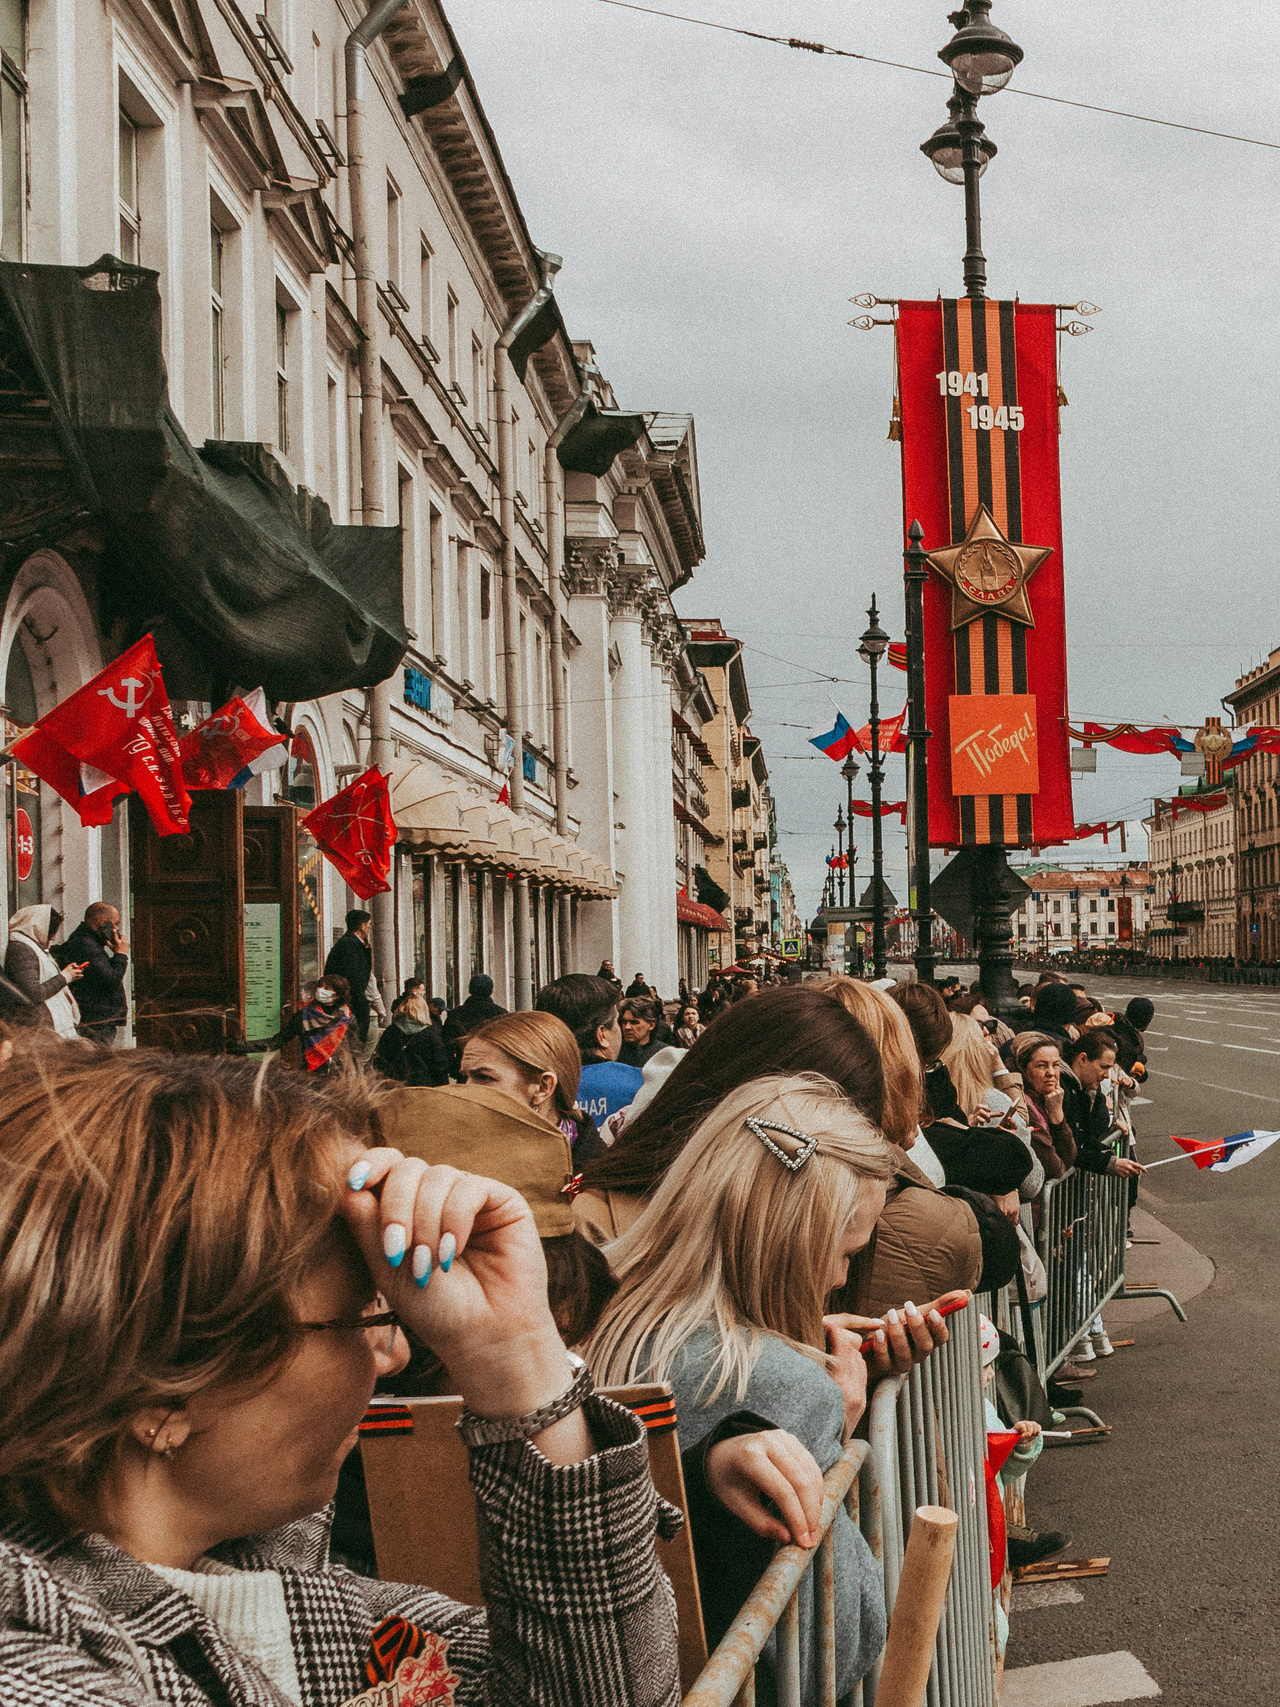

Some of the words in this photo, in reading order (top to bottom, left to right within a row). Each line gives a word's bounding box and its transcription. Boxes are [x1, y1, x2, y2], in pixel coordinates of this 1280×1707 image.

[936, 371, 989, 397] 1941
[966, 405, 1025, 431] 1945
[968, 584, 1013, 600] СЛАВА
[122, 733, 151, 755] 79
[954, 711, 1036, 778] Победа!
